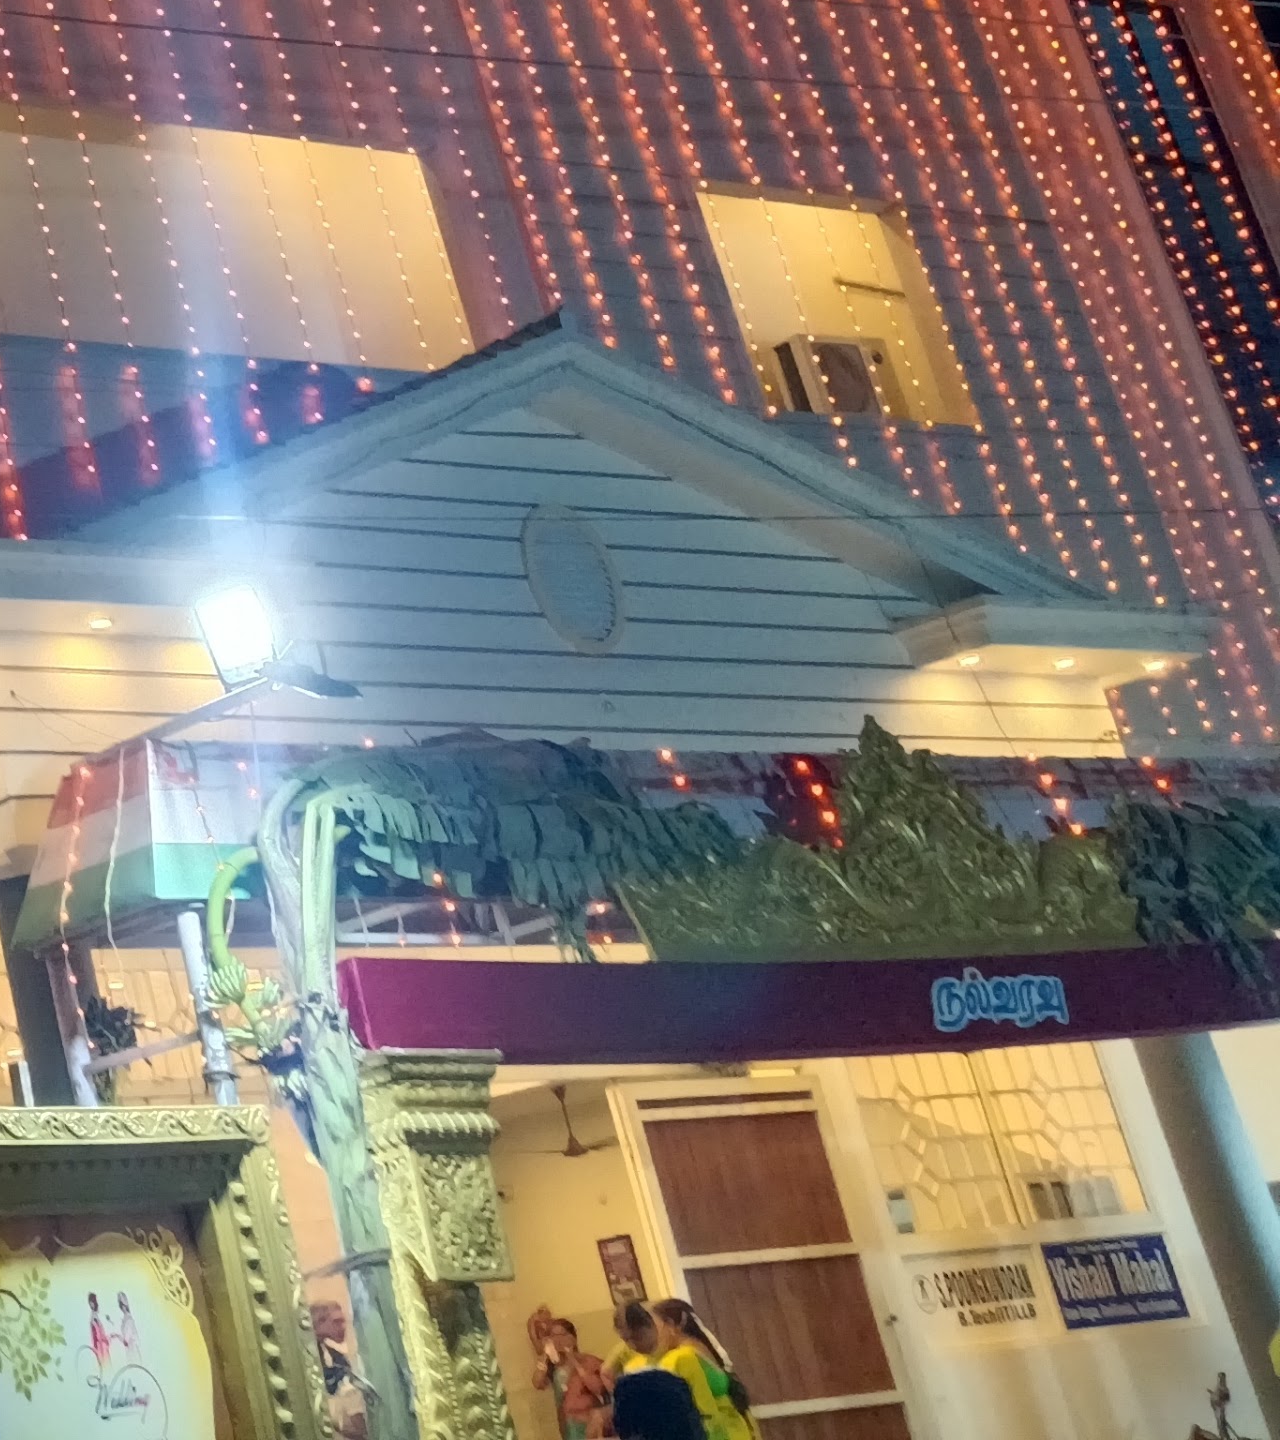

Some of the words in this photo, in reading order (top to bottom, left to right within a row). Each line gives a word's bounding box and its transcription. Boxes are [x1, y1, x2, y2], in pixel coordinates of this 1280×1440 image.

[931, 966, 1070, 1033] நல்வரவு
[1047, 1253, 1117, 1302] Vishali
[1110, 1247, 1175, 1296] Mahal
